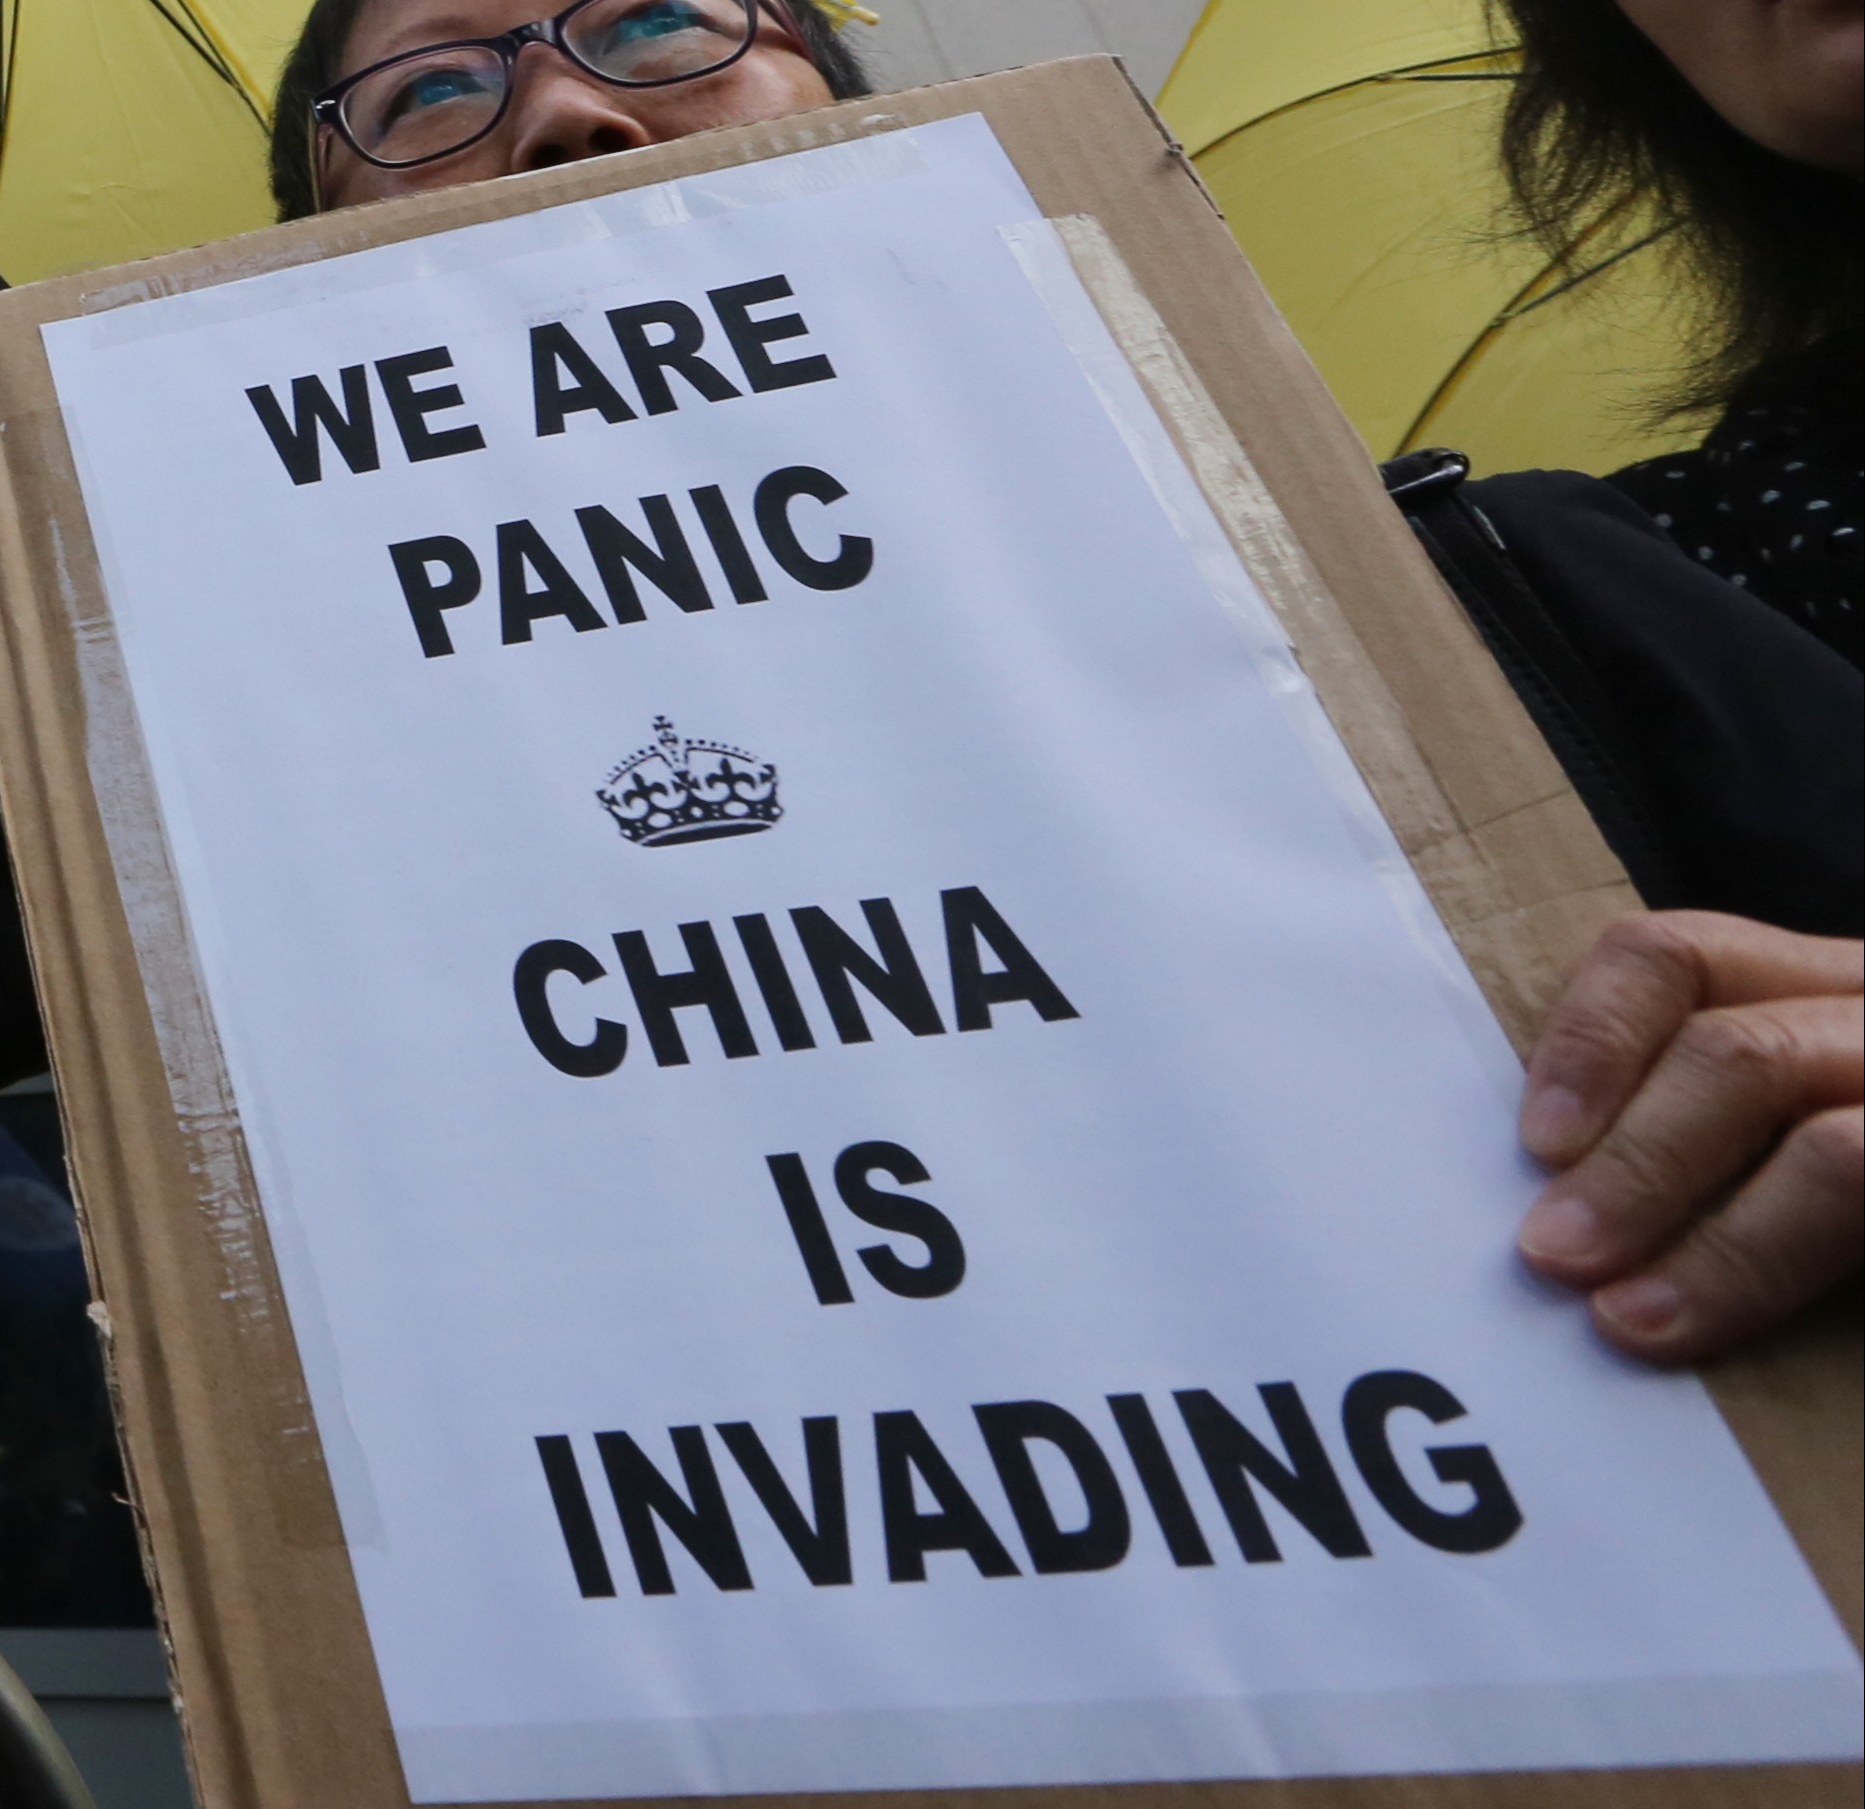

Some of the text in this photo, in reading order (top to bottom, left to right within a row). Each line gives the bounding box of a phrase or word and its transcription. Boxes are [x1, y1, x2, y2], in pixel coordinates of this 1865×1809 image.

[246, 273, 836, 487] WE ARE
[387, 464, 874, 659] PANIC
[512, 885, 1081, 1078] CHINA
[766, 1140, 967, 1306] IS
[533, 1368, 1526, 1601] INVADING
